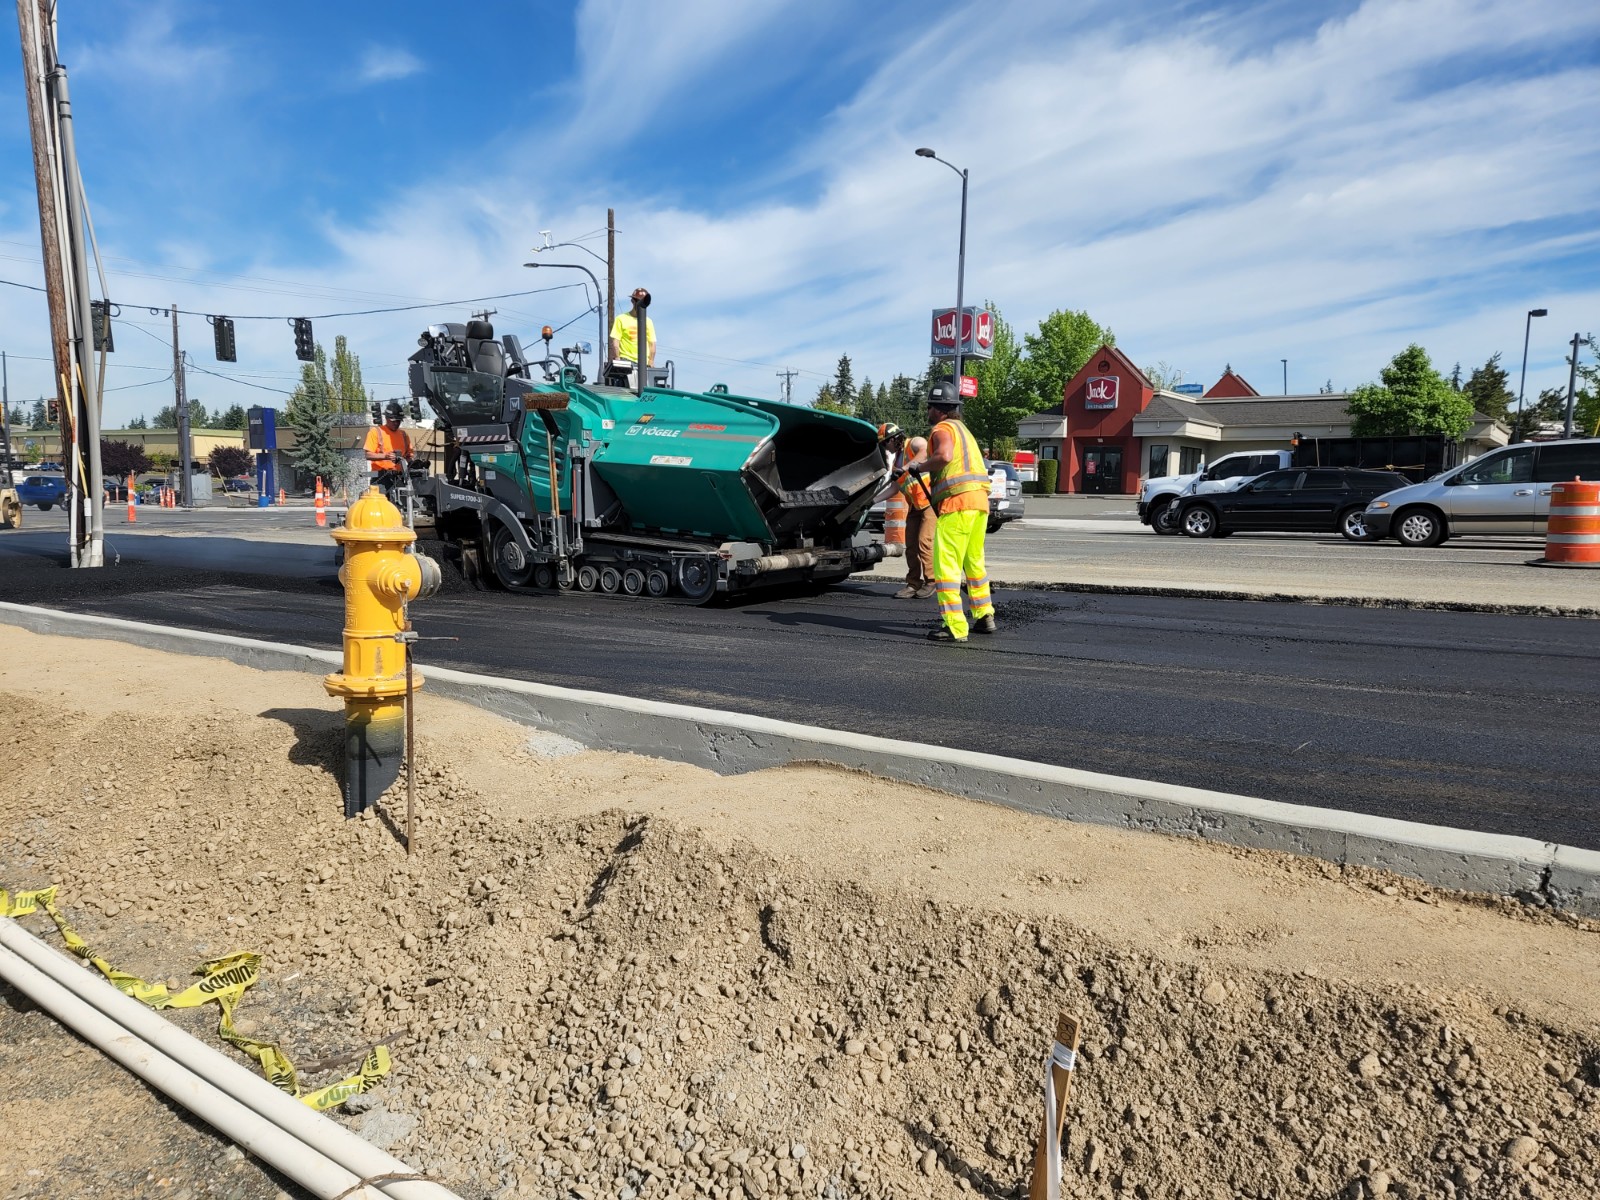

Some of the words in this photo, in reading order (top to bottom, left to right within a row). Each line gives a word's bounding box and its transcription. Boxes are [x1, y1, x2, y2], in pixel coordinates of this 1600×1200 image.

[1086, 381, 1115, 400] Jack
[642, 427, 681, 438] VÖGELE
[450, 493, 465, 501] SUPER
